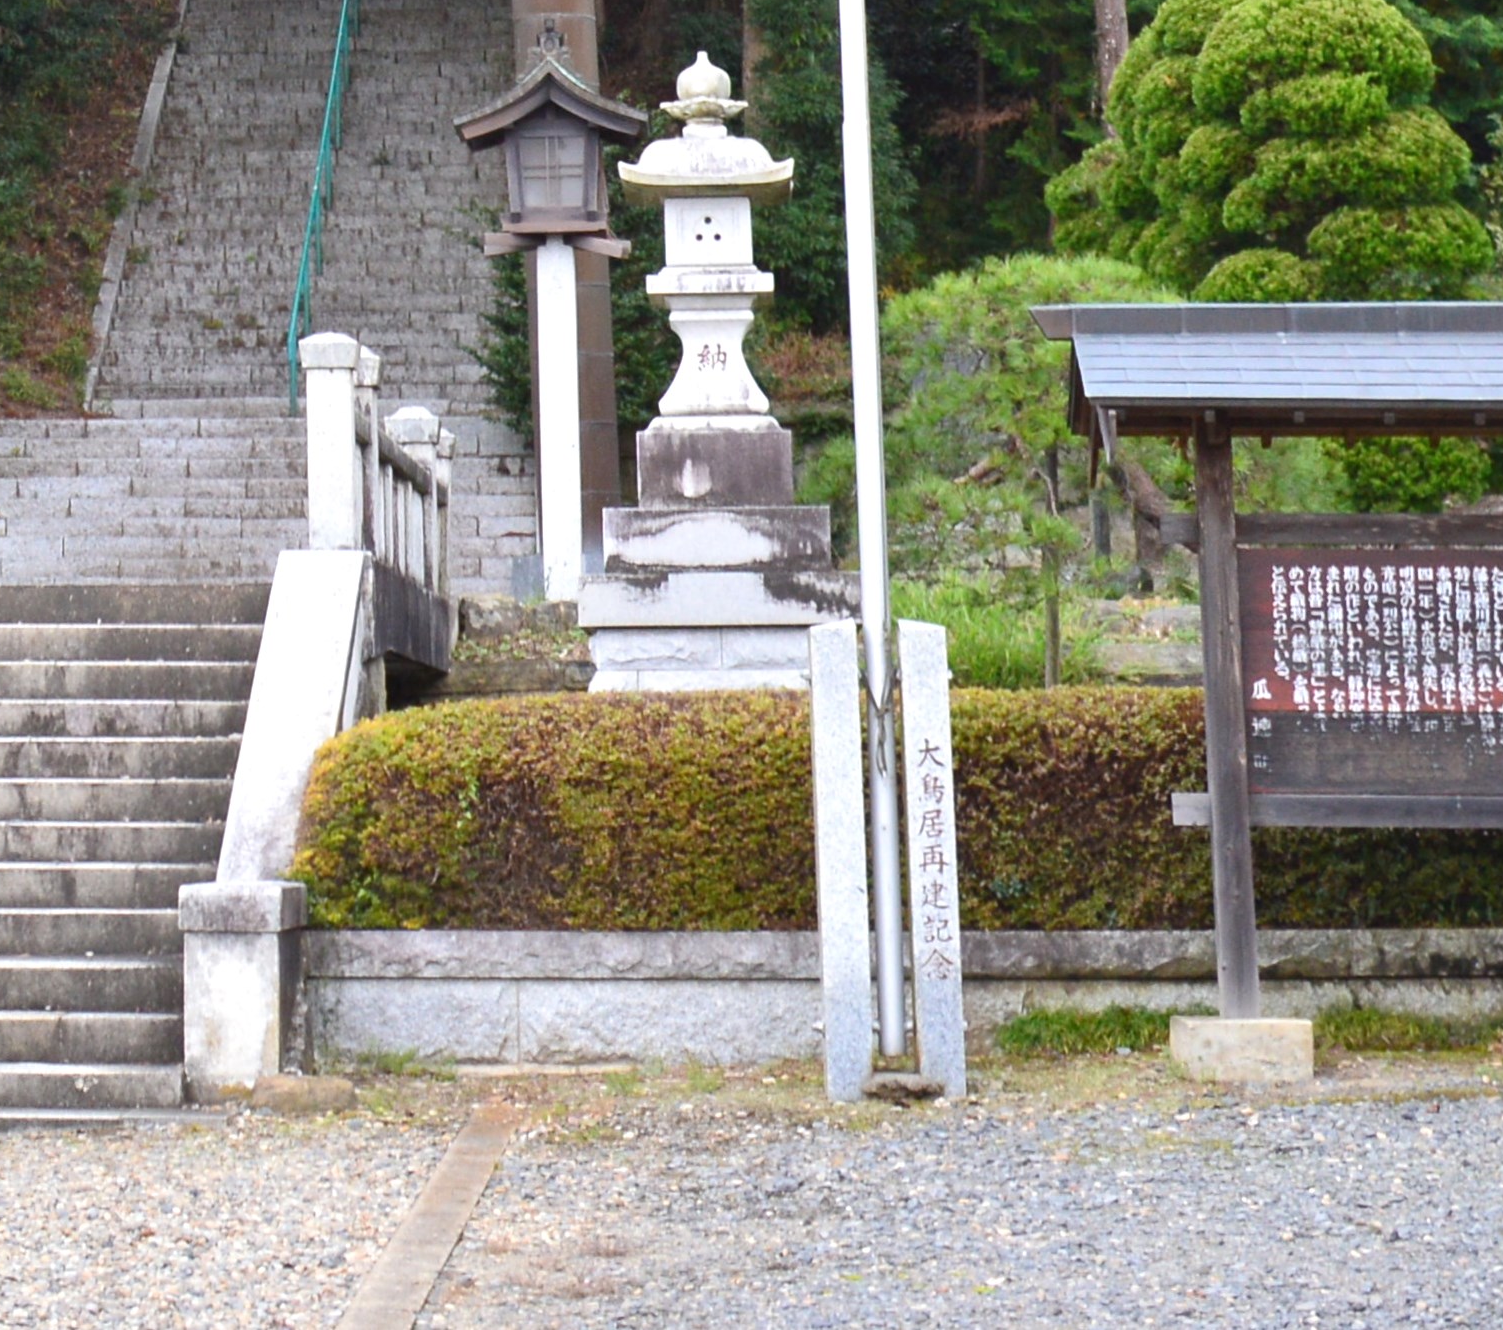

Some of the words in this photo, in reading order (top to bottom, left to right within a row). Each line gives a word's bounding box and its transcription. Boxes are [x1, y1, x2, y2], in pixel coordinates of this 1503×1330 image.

[697, 343, 727, 371] 納
[917, 738, 954, 981] 大鳥居再建記念
